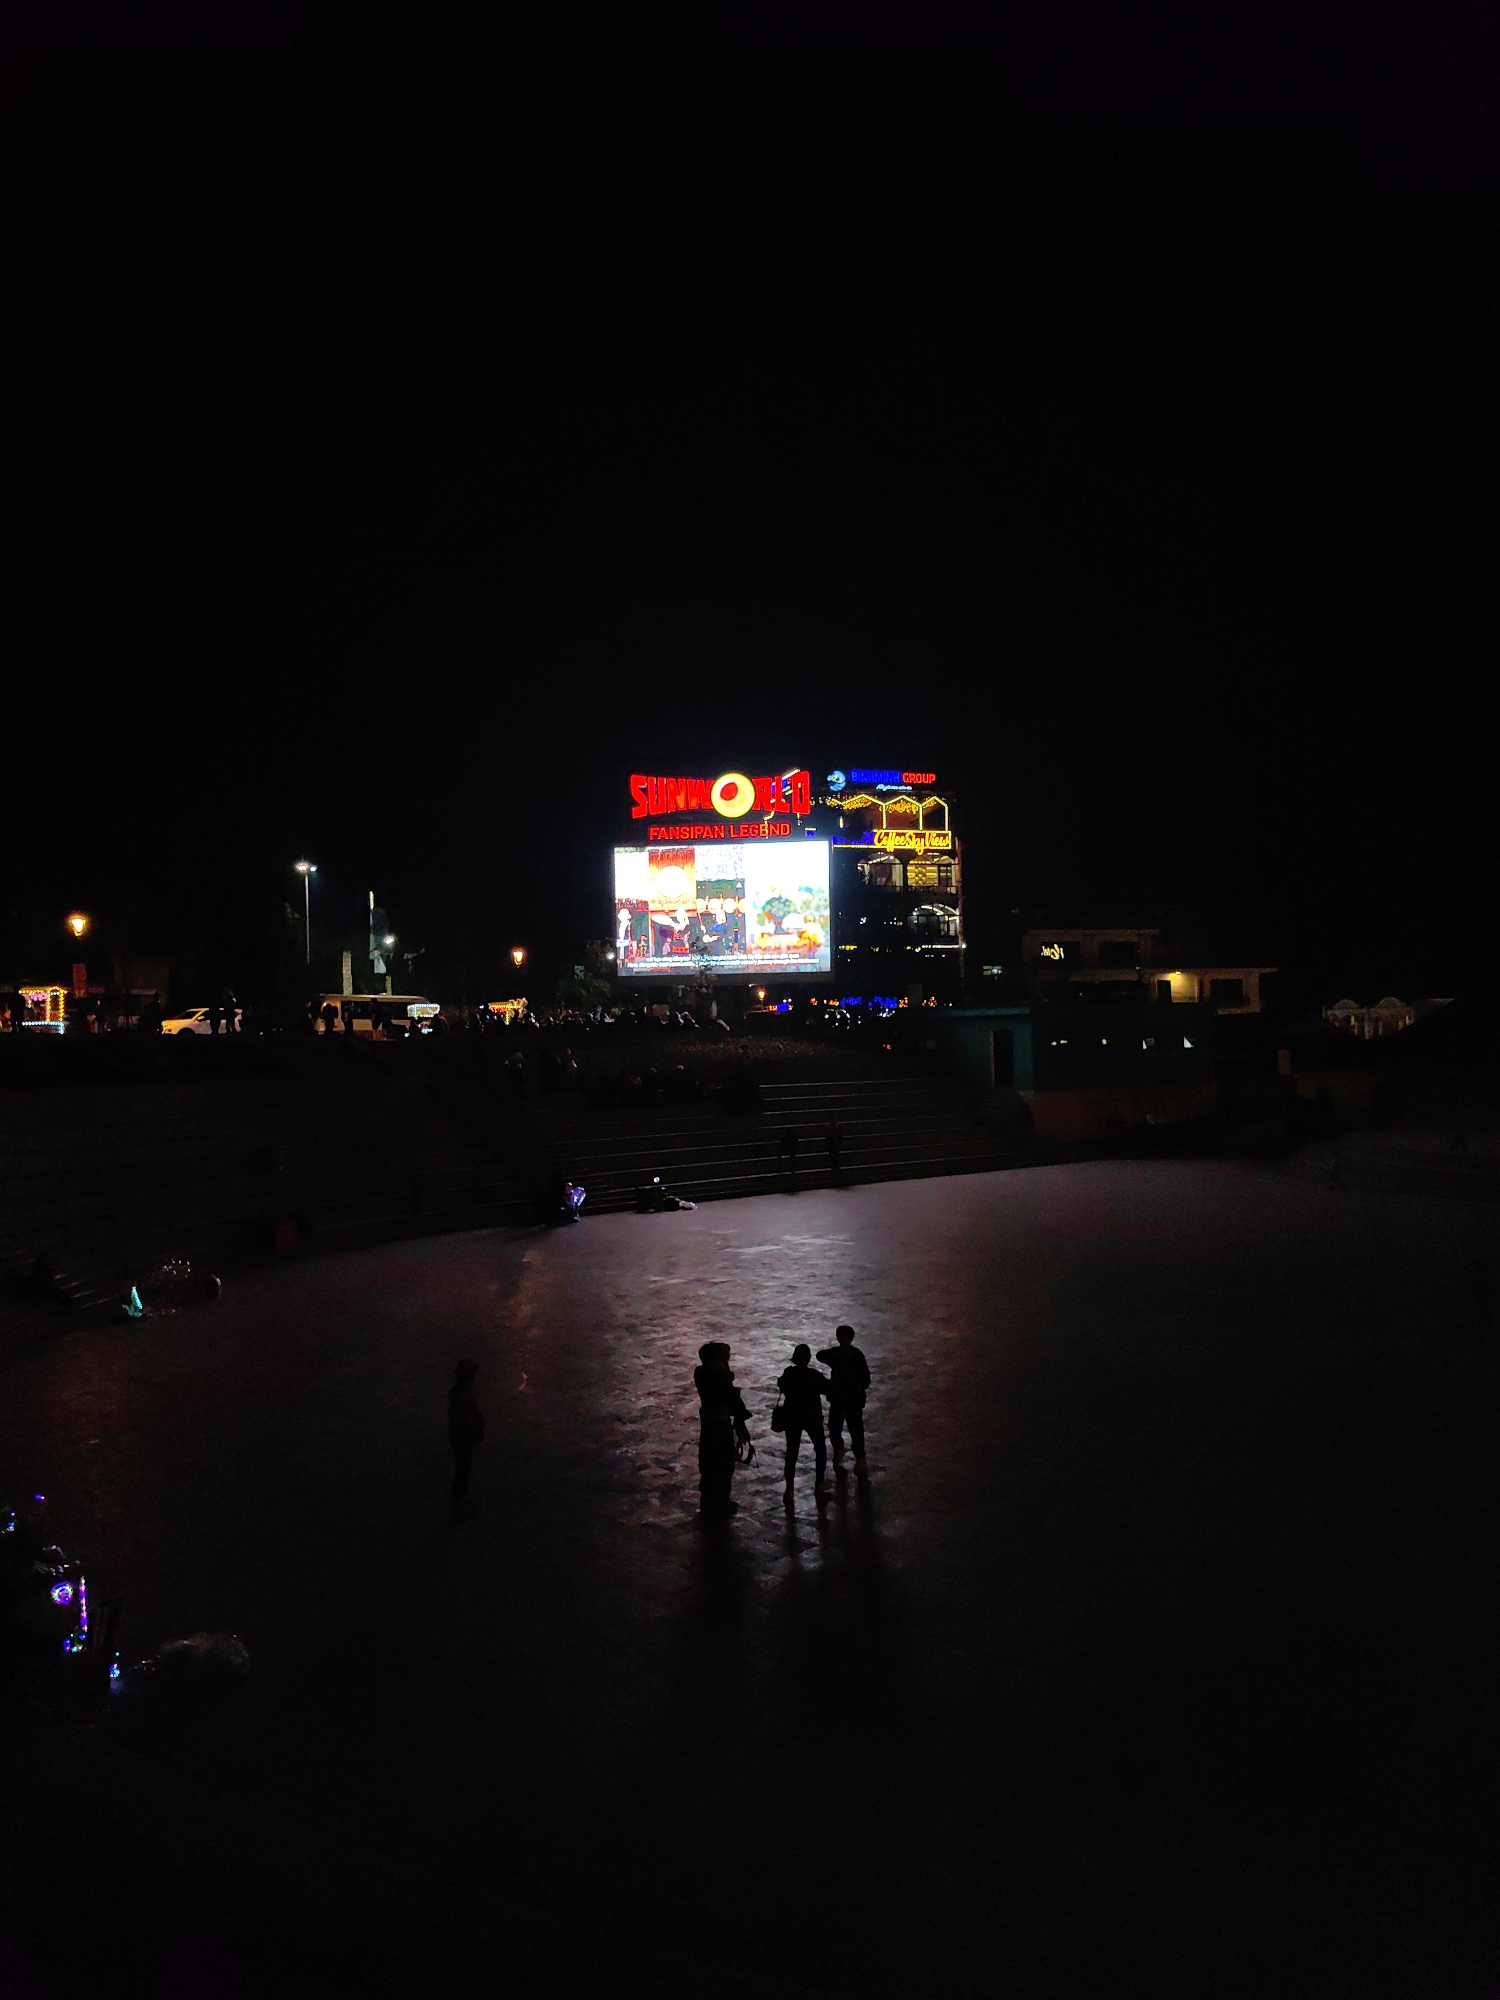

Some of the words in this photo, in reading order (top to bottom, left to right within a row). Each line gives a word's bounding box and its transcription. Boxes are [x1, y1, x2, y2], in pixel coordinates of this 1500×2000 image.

[902, 772, 936, 784] GROUP
[649, 825, 725, 840] FANSIPAN
[729, 822, 791, 838] LEGEND
